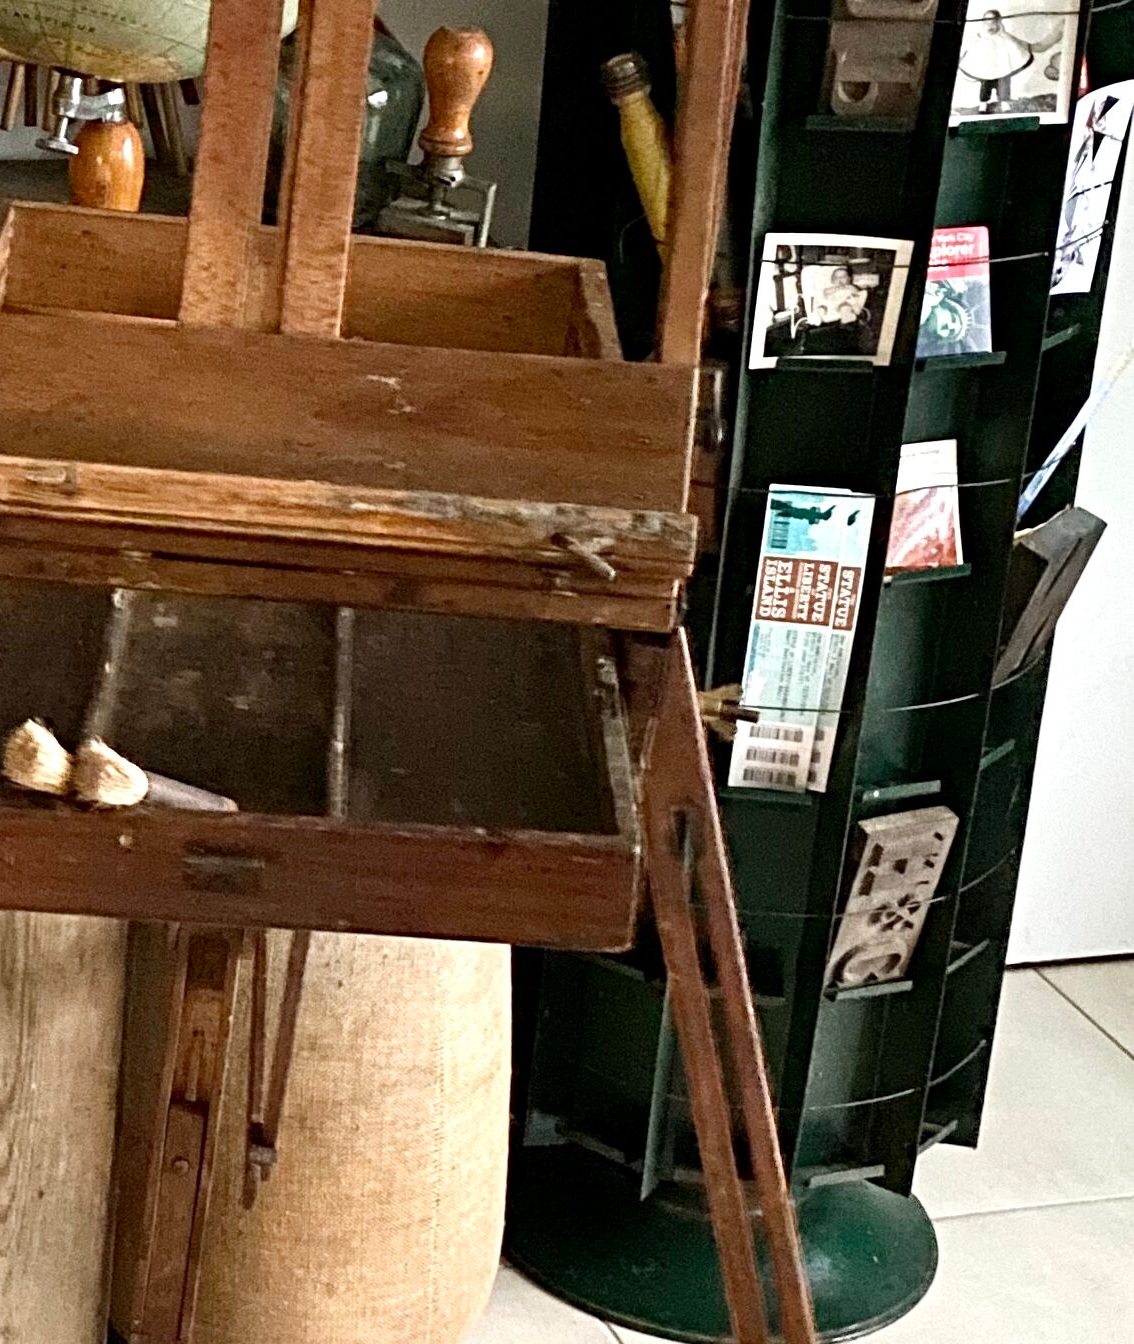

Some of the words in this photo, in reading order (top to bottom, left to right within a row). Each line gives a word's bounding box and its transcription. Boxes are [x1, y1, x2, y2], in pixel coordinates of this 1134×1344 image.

[930, 242, 974, 259] plorer
[759, 559, 778, 618] ISLAND
[771, 560, 793, 619] ELLIS
[797, 562, 815, 621] LIBERTY
[811, 563, 832, 623] STATUE
[834, 569, 855, 628] STATUE
